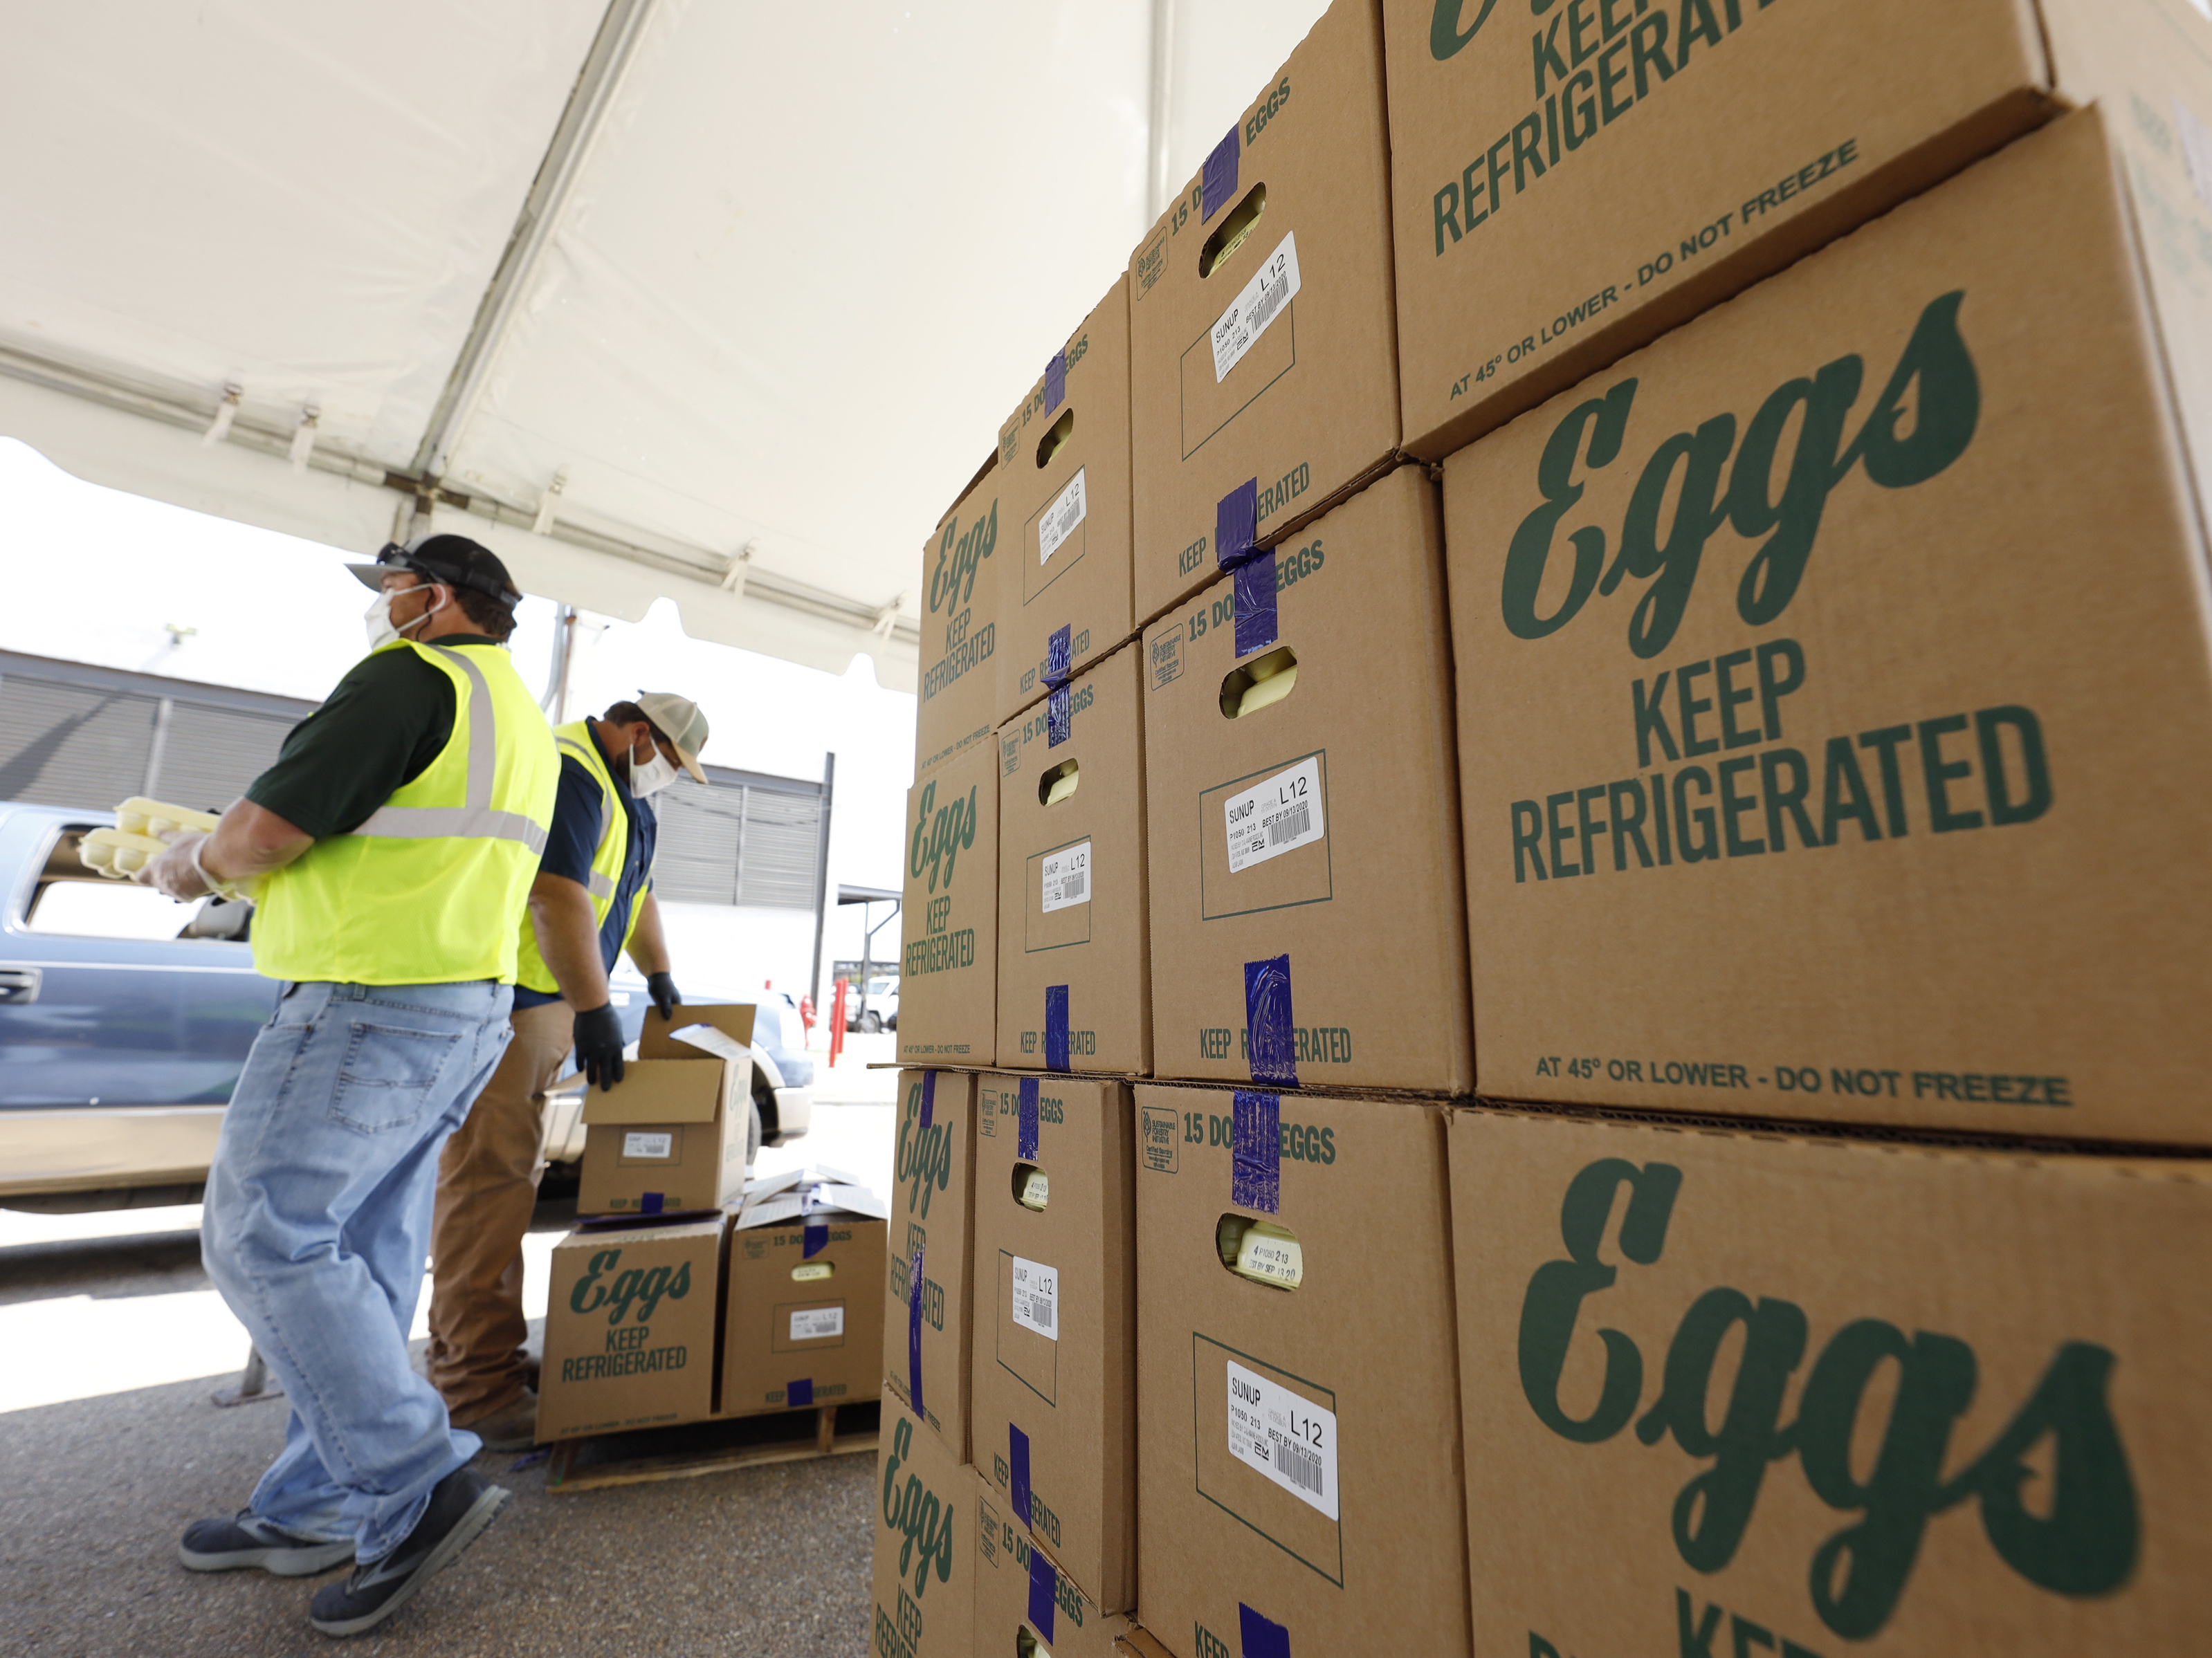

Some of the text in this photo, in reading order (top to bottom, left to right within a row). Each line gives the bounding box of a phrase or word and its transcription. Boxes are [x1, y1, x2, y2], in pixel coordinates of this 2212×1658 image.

[1533, 0, 1648, 102] KEE
[1172, 76, 1291, 237] 15 EGGS
[1450, 374, 1471, 402] AT
[1507, 335, 1536, 365] OR
[1540, 286, 1619, 345] LOWER
[1638, 252, 1673, 286] DO
[1680, 212, 1733, 261] NOT
[1740, 137, 1859, 224] FREEZE
[1216, 308, 1238, 343] SUNUP
[1232, 326, 1241, 342] 213
[1246, 305, 1257, 324] BEST
[1258, 296, 1264, 309] BY
[1264, 270, 1286, 300] 09/13/2020
[1022, 333, 1088, 427] 15 EGGS
[1501, 289, 1982, 659] Eggs
[1041, 513, 1054, 534] SUNUP
[929, 497, 998, 618] Eggs
[1179, 536, 1206, 578] KEEP
[1189, 609, 1207, 642] 15
[1275, 540, 1324, 594] EGGS
[945, 607, 971, 655] KEEP
[923, 622, 995, 703] REFRIGERATED
[1020, 667, 1036, 695] KEEP
[1023, 721, 1033, 744] 15
[1070, 683, 1094, 717] EGGS
[1631, 638, 1807, 768] KEEP
[939, 745, 953, 759] LOWER
[956, 740, 962, 750] DO
[963, 735, 972, 746] NOT
[972, 724, 990, 741] FREEZE
[1230, 800, 1254, 825] SUNUP
[1510, 703, 2054, 883] REFRIGERATED
[911, 779, 977, 894] Eggs
[1230, 800, 1308, 840] P1050 213 BEST BY 09/13/2020
[1045, 862, 1059, 876] SUNUP
[926, 895, 951, 936] KEEP
[906, 928, 974, 977] REFRIGERATED
[915, 1045, 920, 1053] OR
[921, 1045, 934, 1053] LOWER
[937, 1044, 943, 1053] DO
[944, 1044, 953, 1053] NOT
[953, 1044, 970, 1053] FREEZE
[1021, 1031, 1036, 1053] KEEP
[1200, 1028, 1232, 1060] KEEP
[1536, 1056, 1562, 1077] AT
[1607, 1059, 1644, 1082] OR
[1651, 1061, 1750, 1089] LOWER
[1777, 1066, 1821, 1093] DO
[1832, 1069, 1901, 1098] NOT
[1914, 1071, 2073, 1107] FREEZE
[1000, 1093, 1009, 1114] 15
[1040, 1097, 1063, 1124] EGGS
[1152, 1120, 1176, 1130] SUSTAINABLE
[898, 1082, 953, 1220] Eggs
[1152, 1127, 1169, 1136] FORESTRY
[1152, 1135, 1169, 1145] INITIATIVE
[1184, 1112, 1204, 1143] 15
[1279, 1123, 1336, 1166] EGGS
[1254, 1245, 1259, 1256] 4
[570, 1249, 691, 1325] Eggs
[1015, 1267, 1027, 1282] SUNUP
[1257, 1262, 1265, 1271] BY
[1265, 1264, 1275, 1273] SEP
[1286, 1269, 1296, 1281] 20
[605, 1326, 649, 1353] KEEP
[562, 1346, 686, 1382] REFRIGERATED
[1232, 1376, 1261, 1407] SUNUP
[1517, 1157, 2146, 1643] Eggs
[1231, 1404, 1247, 1422] P1050
[1250, 1416, 1261, 1430] 213
[1268, 1427, 1282, 1445] BEST
[1283, 1436, 1292, 1449] BY
[1292, 1443, 1322, 1466] 09/13/2020
[994, 1452, 1009, 1489] KEEP
[884, 1417, 953, 1599] Eggs
[1003, 1522, 1084, 1628] 15 EGGS
[897, 1583, 922, 1655] KEEP
